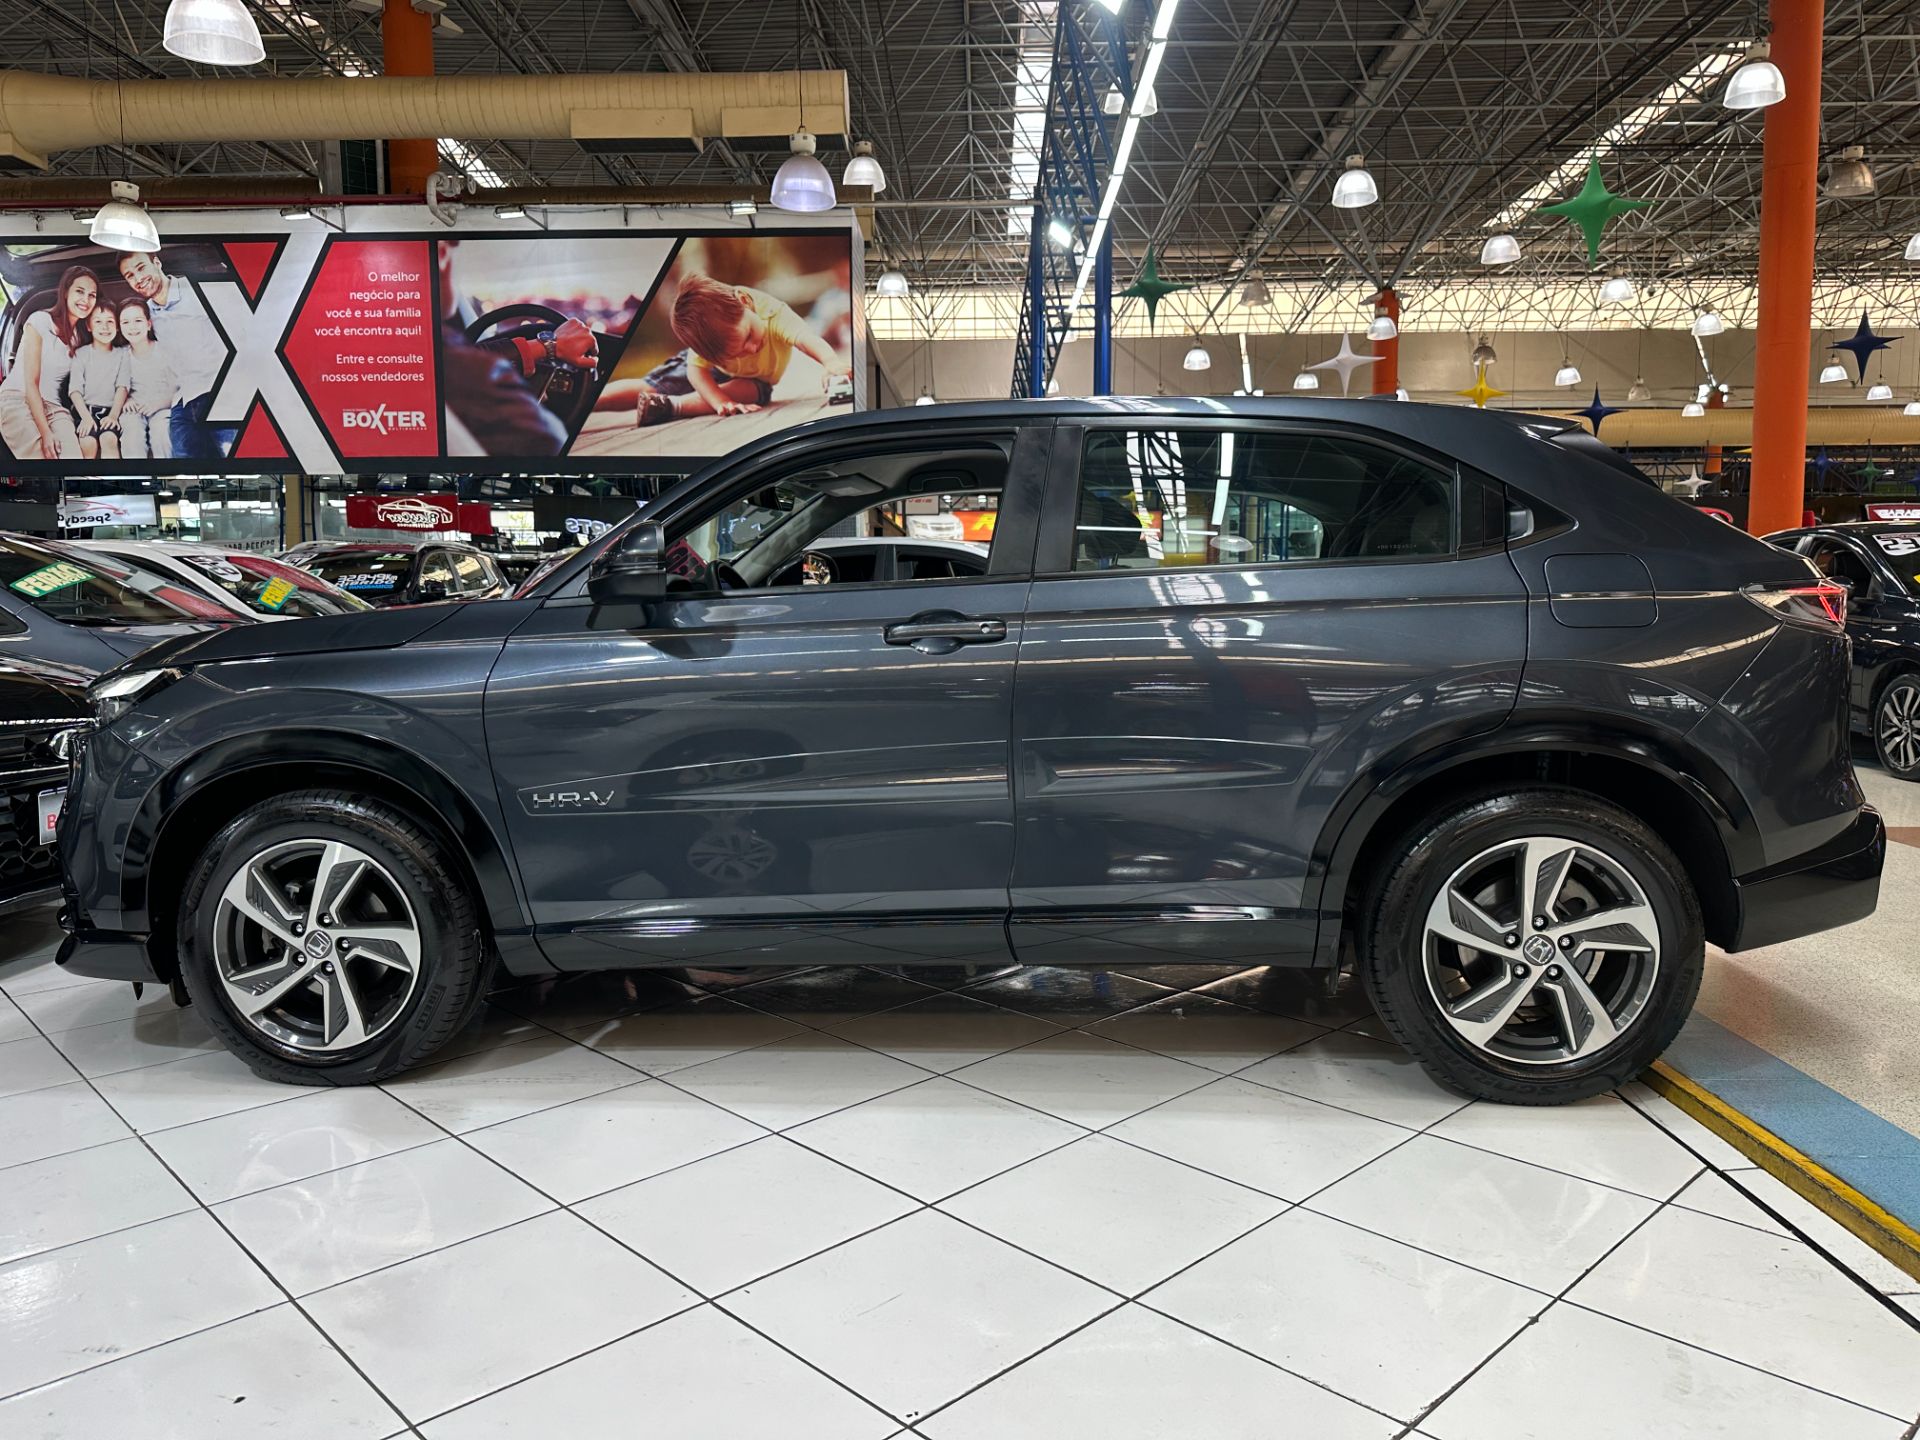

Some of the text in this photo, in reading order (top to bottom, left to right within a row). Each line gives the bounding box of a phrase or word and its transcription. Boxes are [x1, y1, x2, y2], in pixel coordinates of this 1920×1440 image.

[368, 271, 420, 282] O melhor
[349, 289, 420, 303] negócio para
[325, 308, 352, 318] você
[354, 310, 361, 318] e
[364, 310, 383, 318] sua
[314, 325, 422, 338] você encontra aqui!
[336, 353, 424, 364] Entre e consulte
[321, 371, 425, 382] nossos vendedores
[342, 403, 427, 435] BOXTER
[532, 790, 614, 808] HR-V
